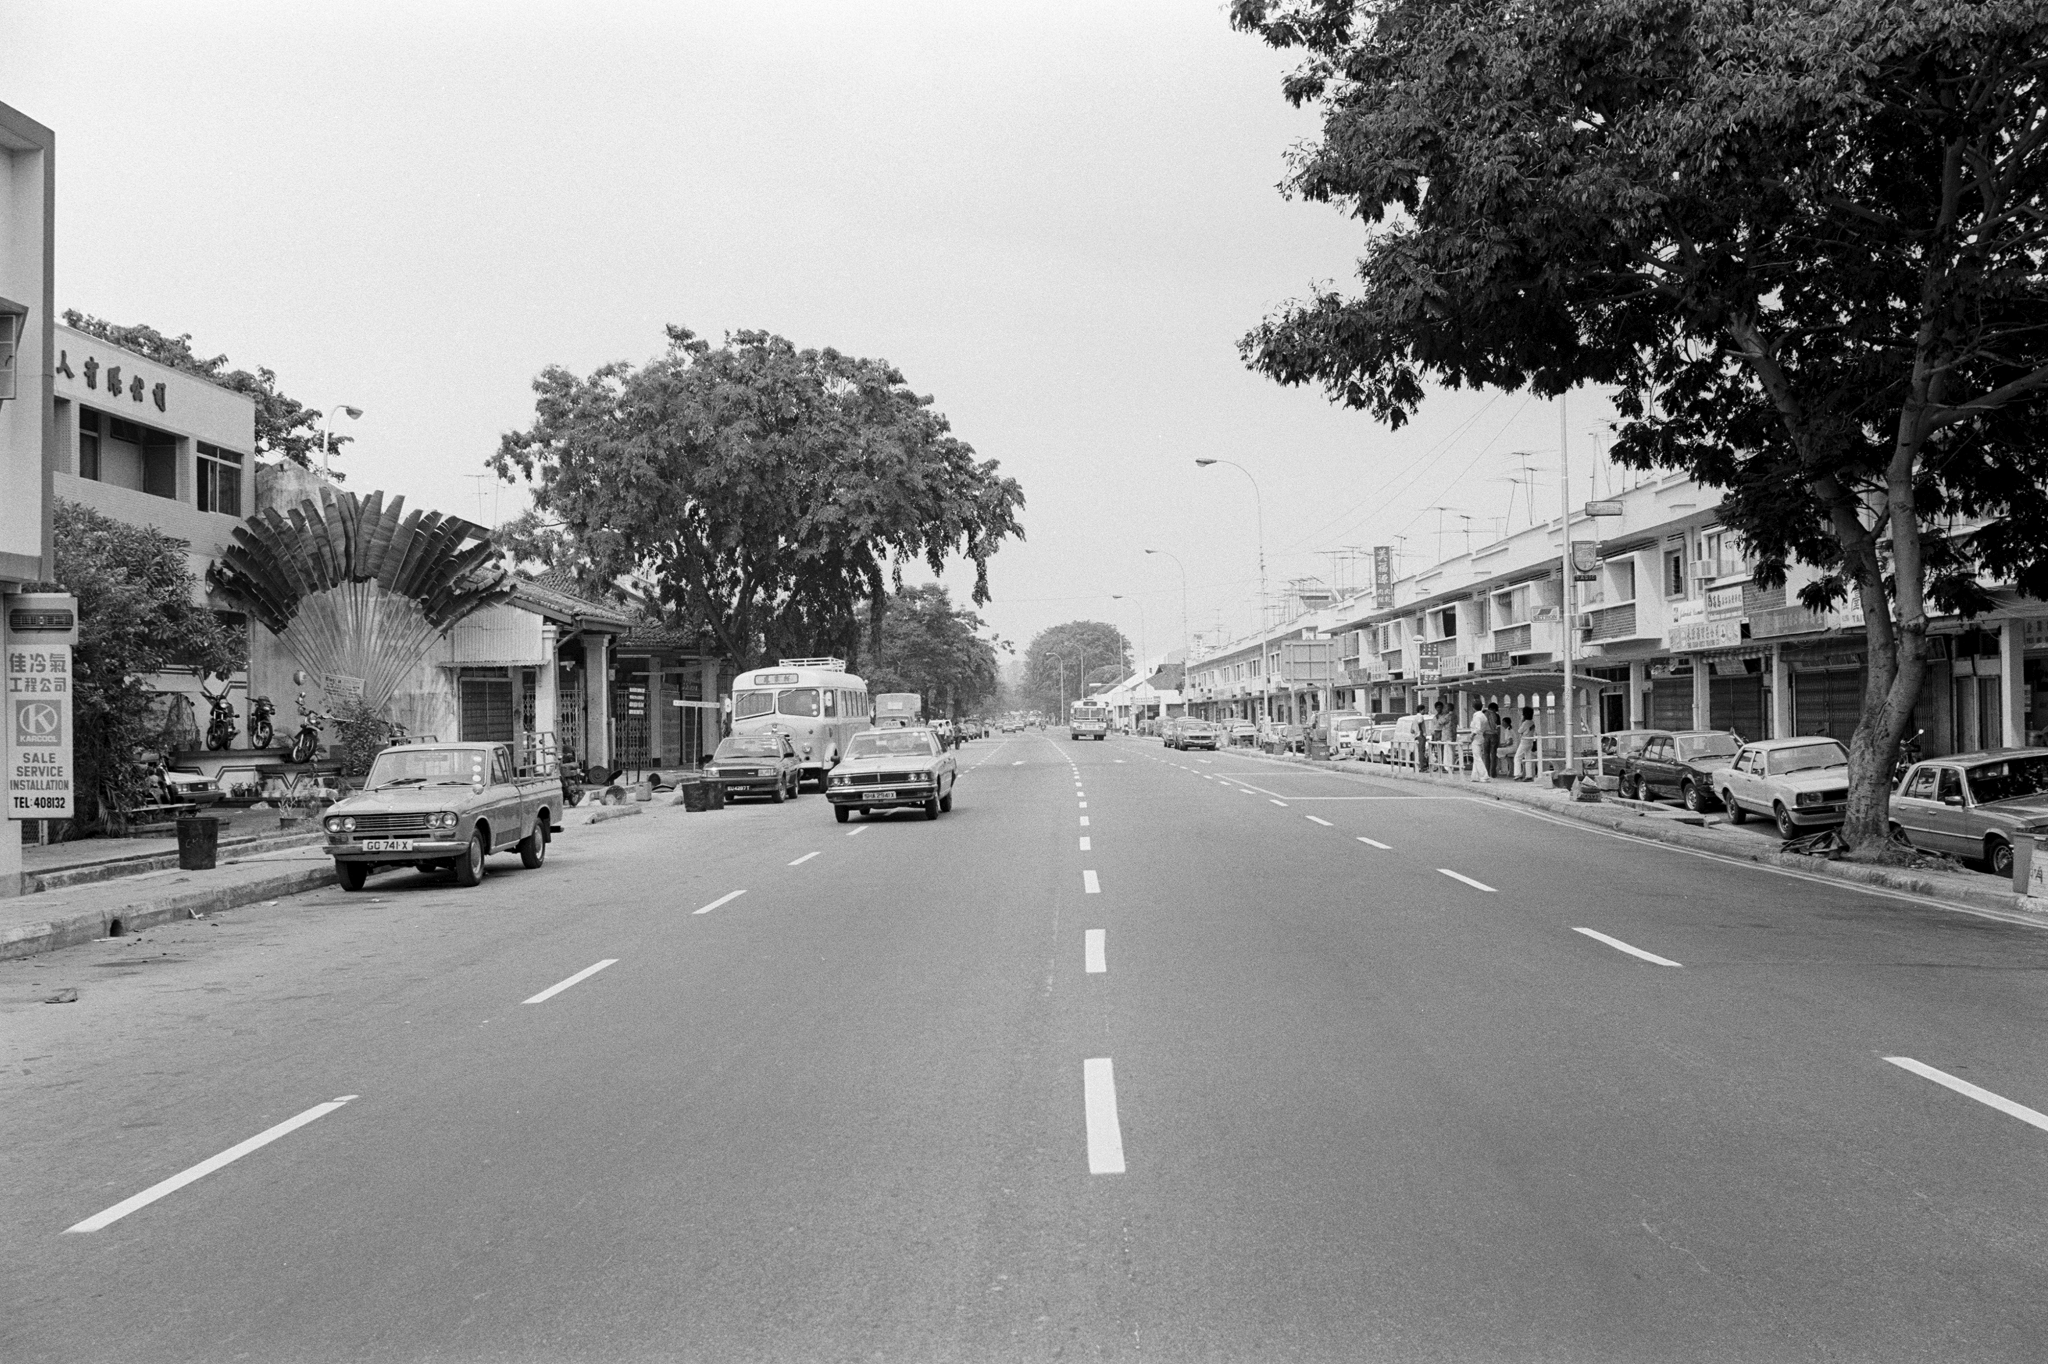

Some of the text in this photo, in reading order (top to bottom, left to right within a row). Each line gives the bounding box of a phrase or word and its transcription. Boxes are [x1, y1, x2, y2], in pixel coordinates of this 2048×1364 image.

[9, 653, 67, 673] 佳冷氣
[9, 677, 67, 692] 工程公司
[23, 753, 56, 763] SALE
[16, 766, 63, 777] SERVICE
[9, 780, 69, 790] INSTALLATION
[383, 841, 398, 850] 741
[402, 841, 408, 849] X
